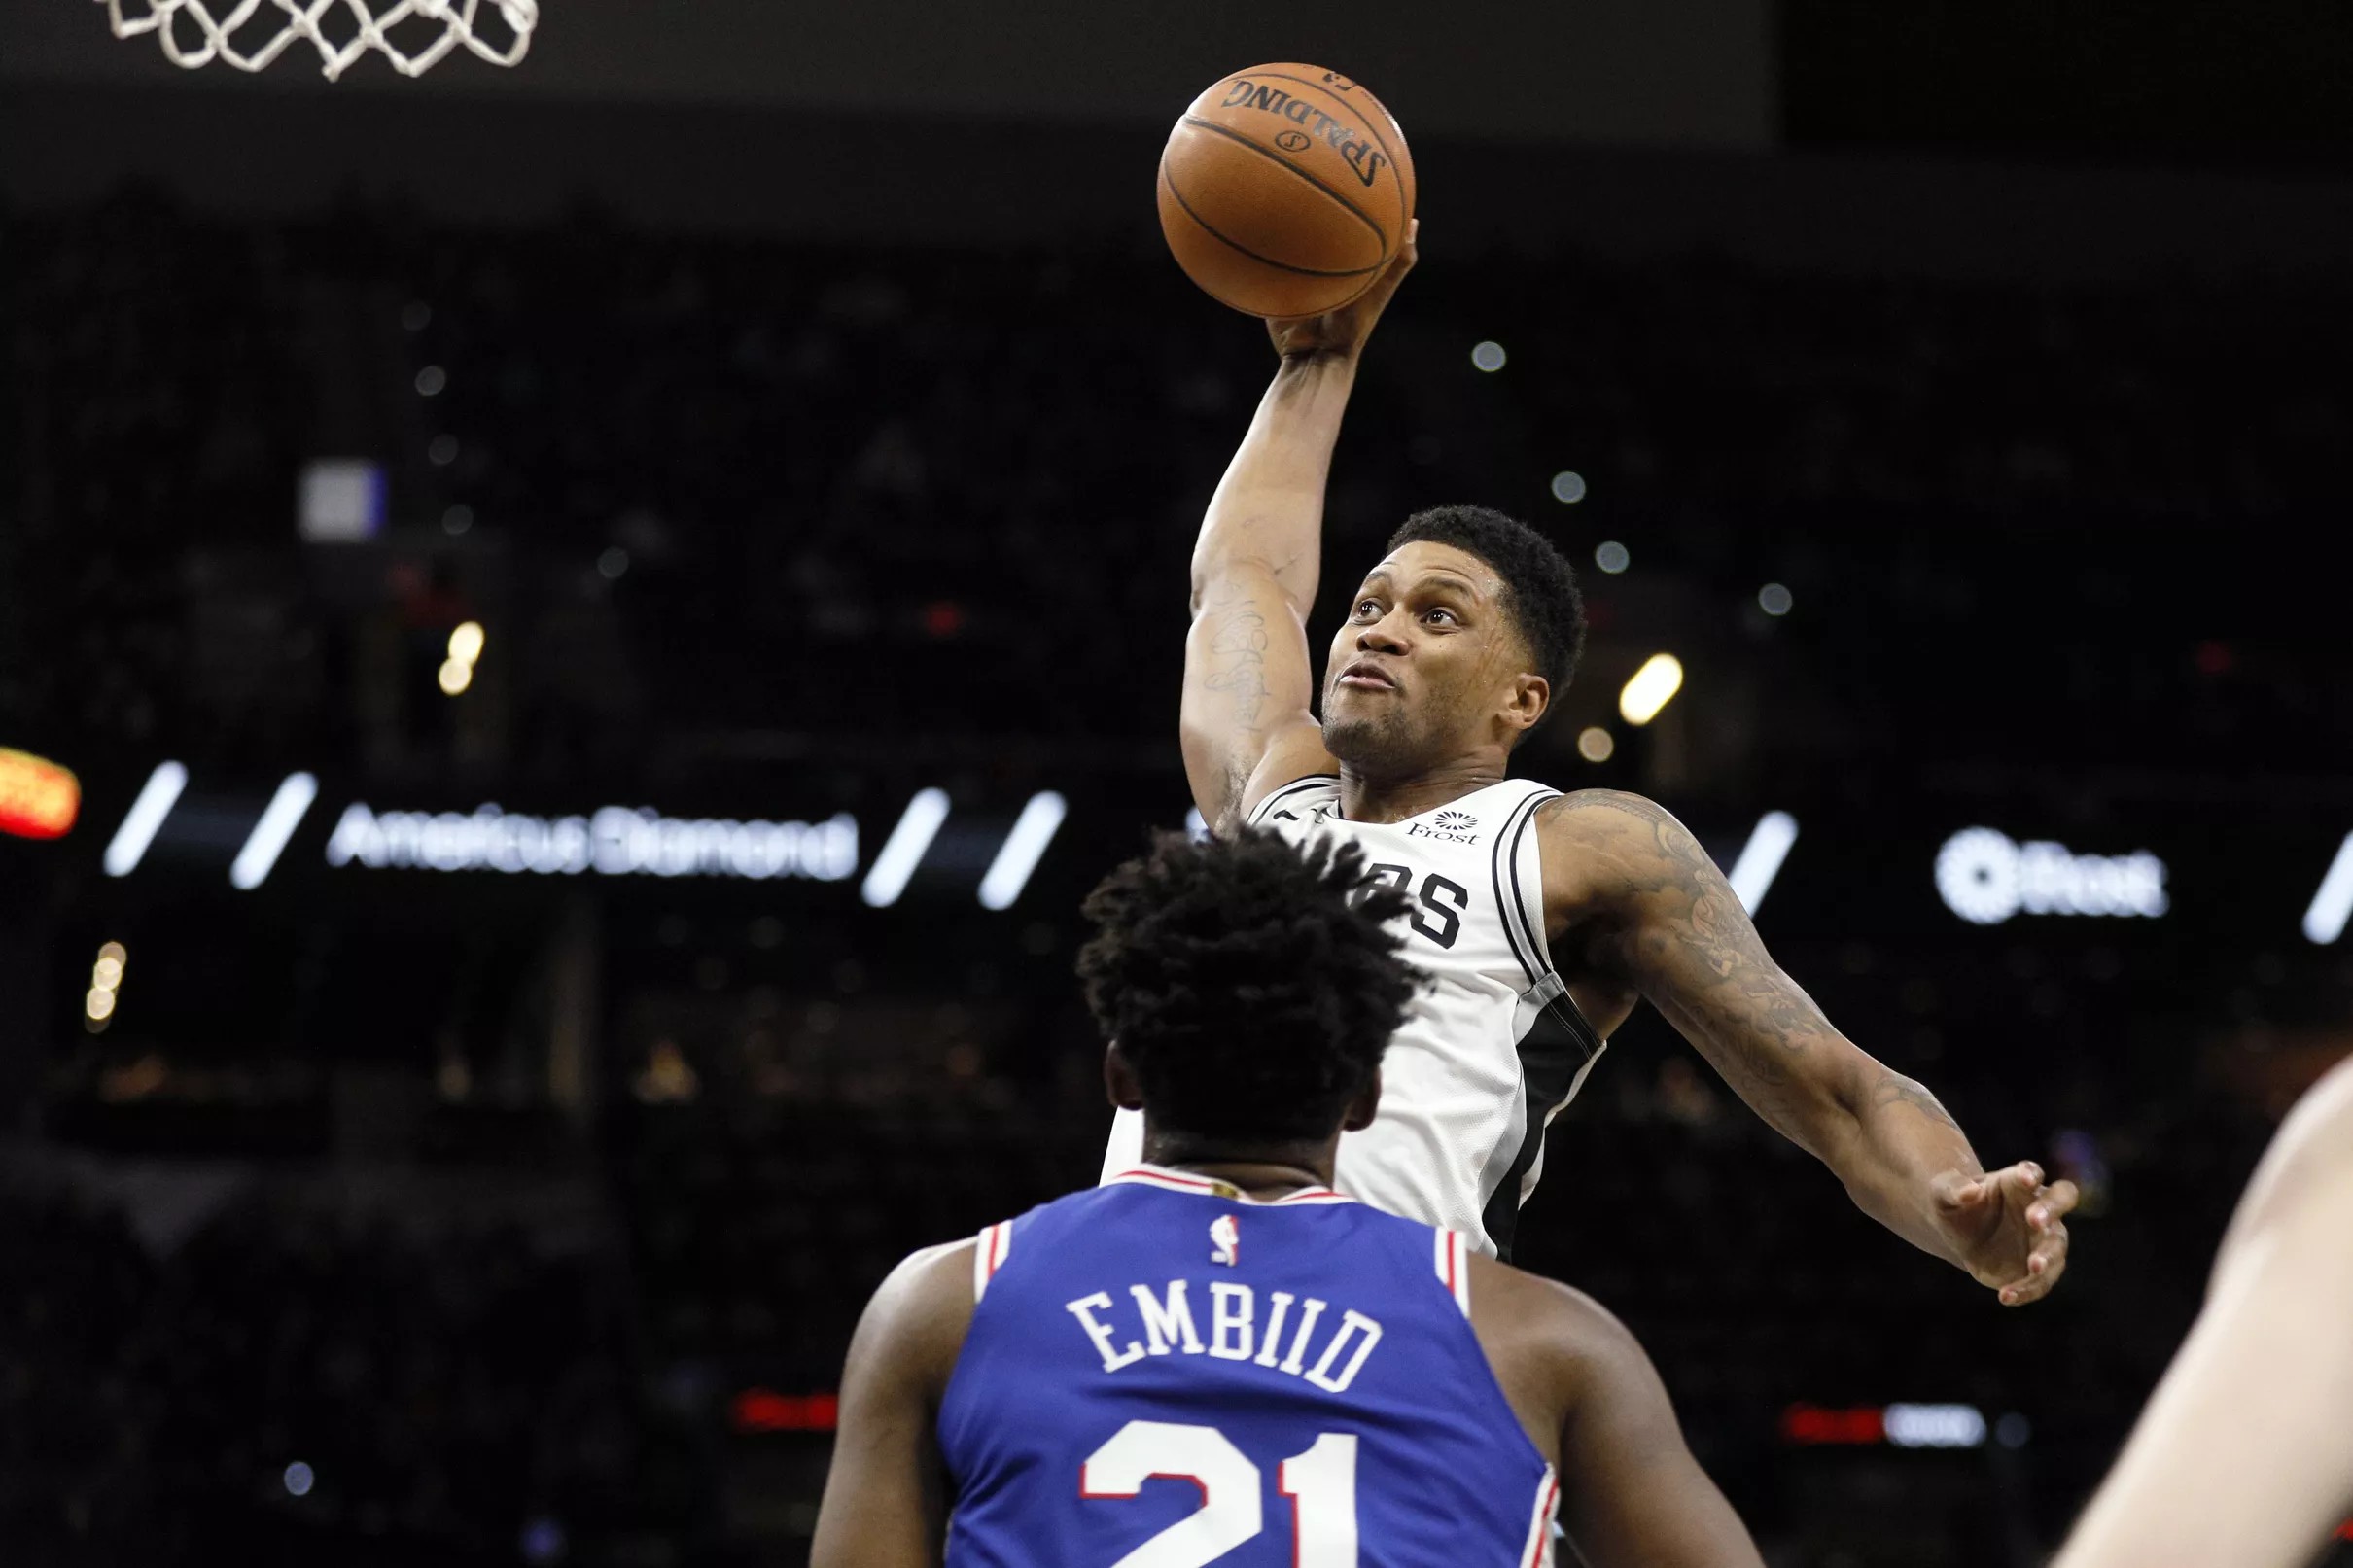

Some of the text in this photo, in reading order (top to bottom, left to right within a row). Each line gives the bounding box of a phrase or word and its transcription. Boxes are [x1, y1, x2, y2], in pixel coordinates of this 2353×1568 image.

[1221, 80, 1387, 188] SPALDING
[1405, 821, 1481, 845] Frost
[1065, 1279, 1384, 1393] EMBIID
[1079, 1420, 1359, 1568] 21
